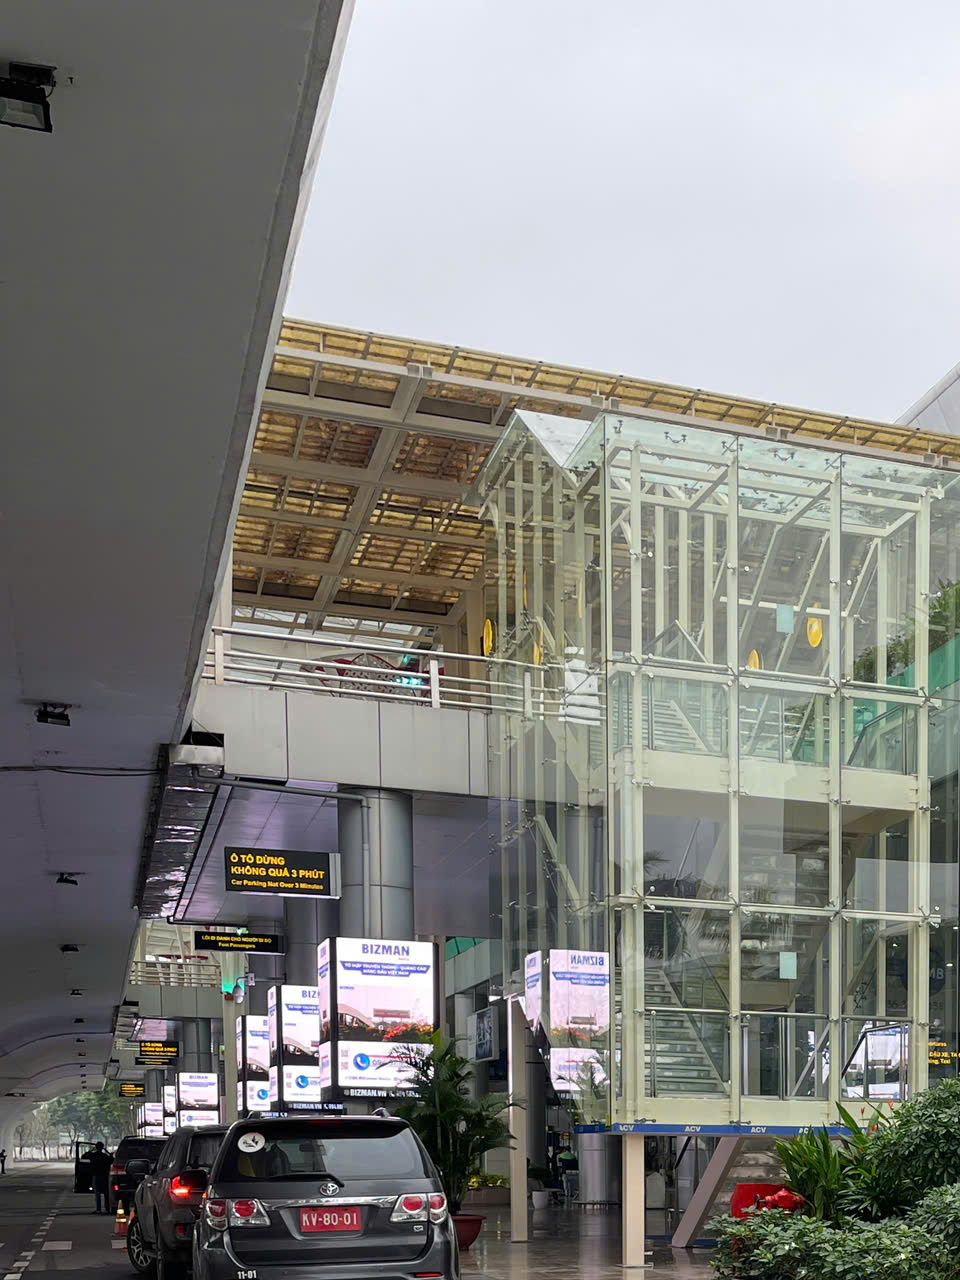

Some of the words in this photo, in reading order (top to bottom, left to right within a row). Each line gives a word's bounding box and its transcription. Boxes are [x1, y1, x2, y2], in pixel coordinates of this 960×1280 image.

[230, 853, 239, 863] Ô
[240, 854, 255, 863] TÔ
[231, 866, 266, 876] KHÔNG
[291, 869, 297, 878] 3
[299, 869, 325, 879] PHÚT
[243, 880, 267, 888] Parking
[362, 944, 410, 956] BIZMAN
[301, 990, 320, 998] BIZ
[302, 1213, 357, 1227] KV-80-01
[237, 1270, 257, 1279] 11-01
